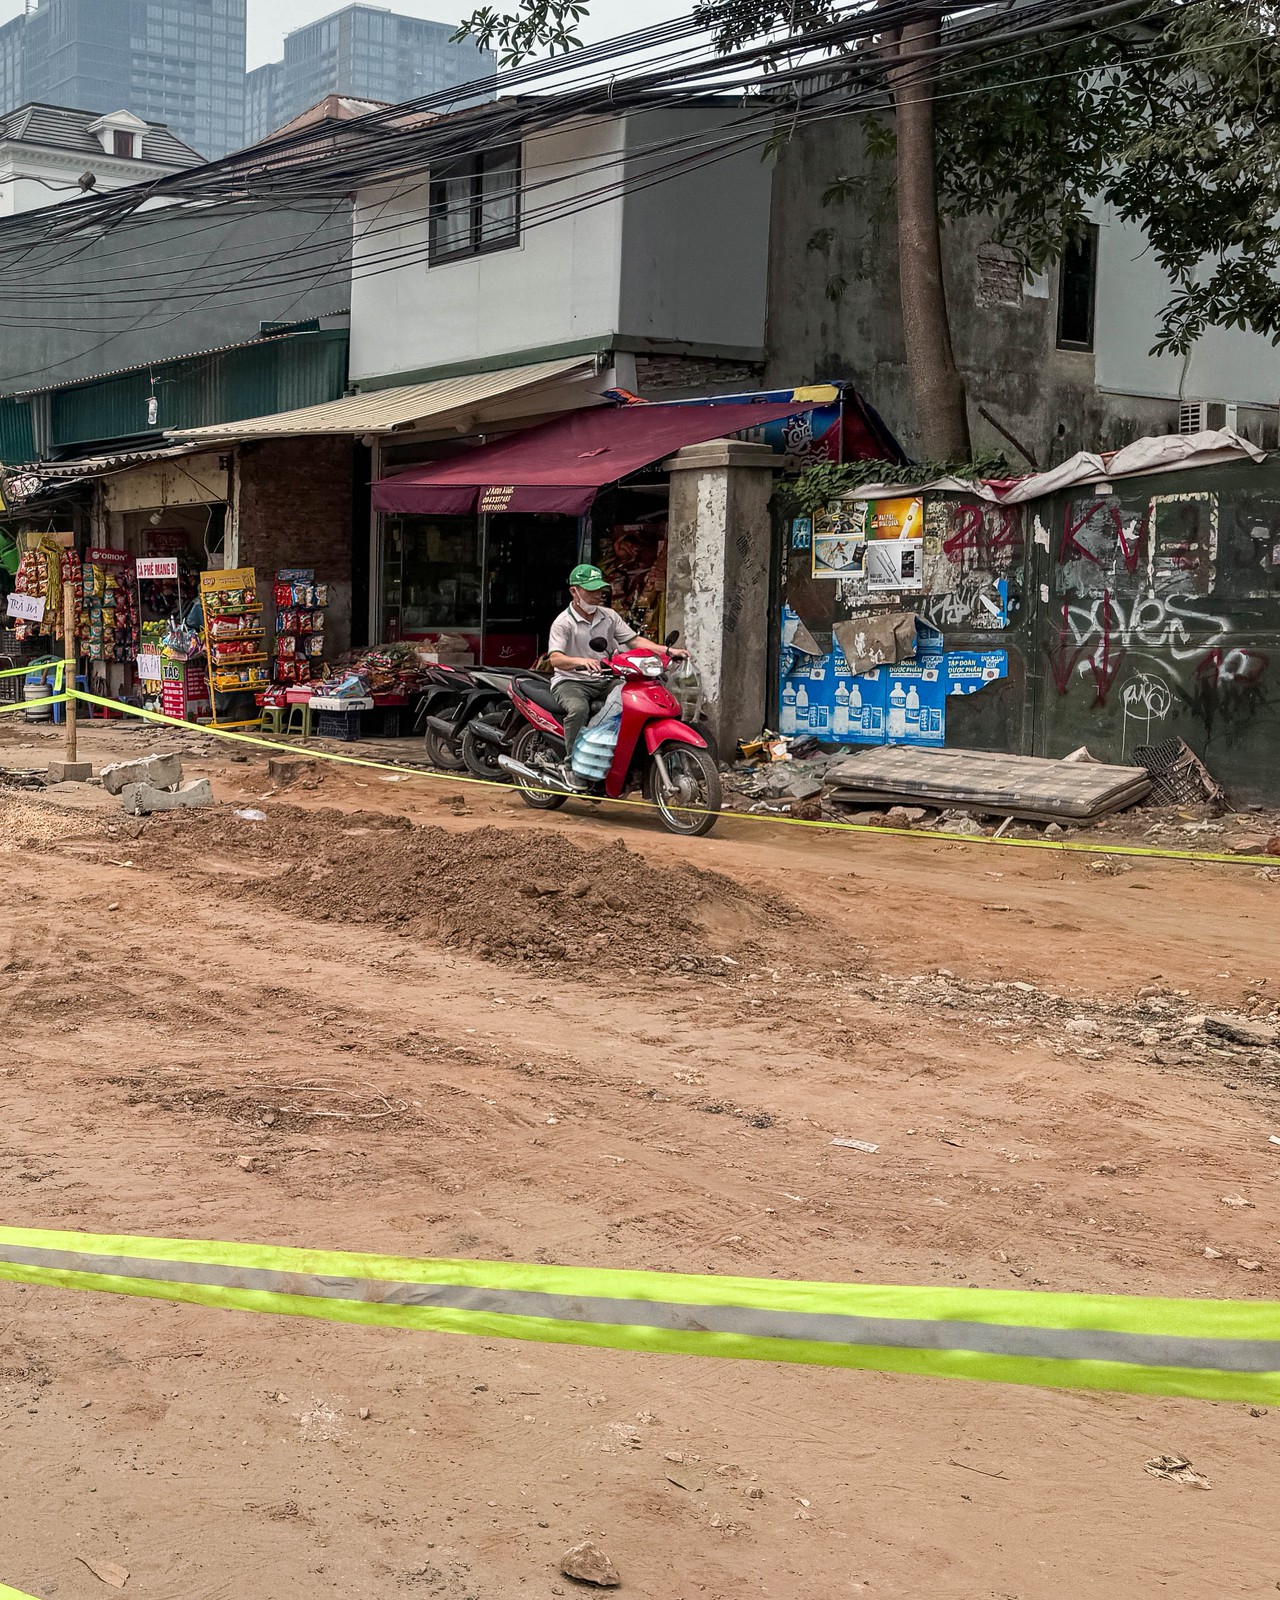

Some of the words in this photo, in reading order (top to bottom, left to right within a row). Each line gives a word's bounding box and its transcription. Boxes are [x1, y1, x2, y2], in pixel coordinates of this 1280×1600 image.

[101, 553, 125, 561] ORION
[144, 561, 154, 576] PHÊ
[155, 563, 170, 576] MANG
[163, 661, 179, 680] TẮC
